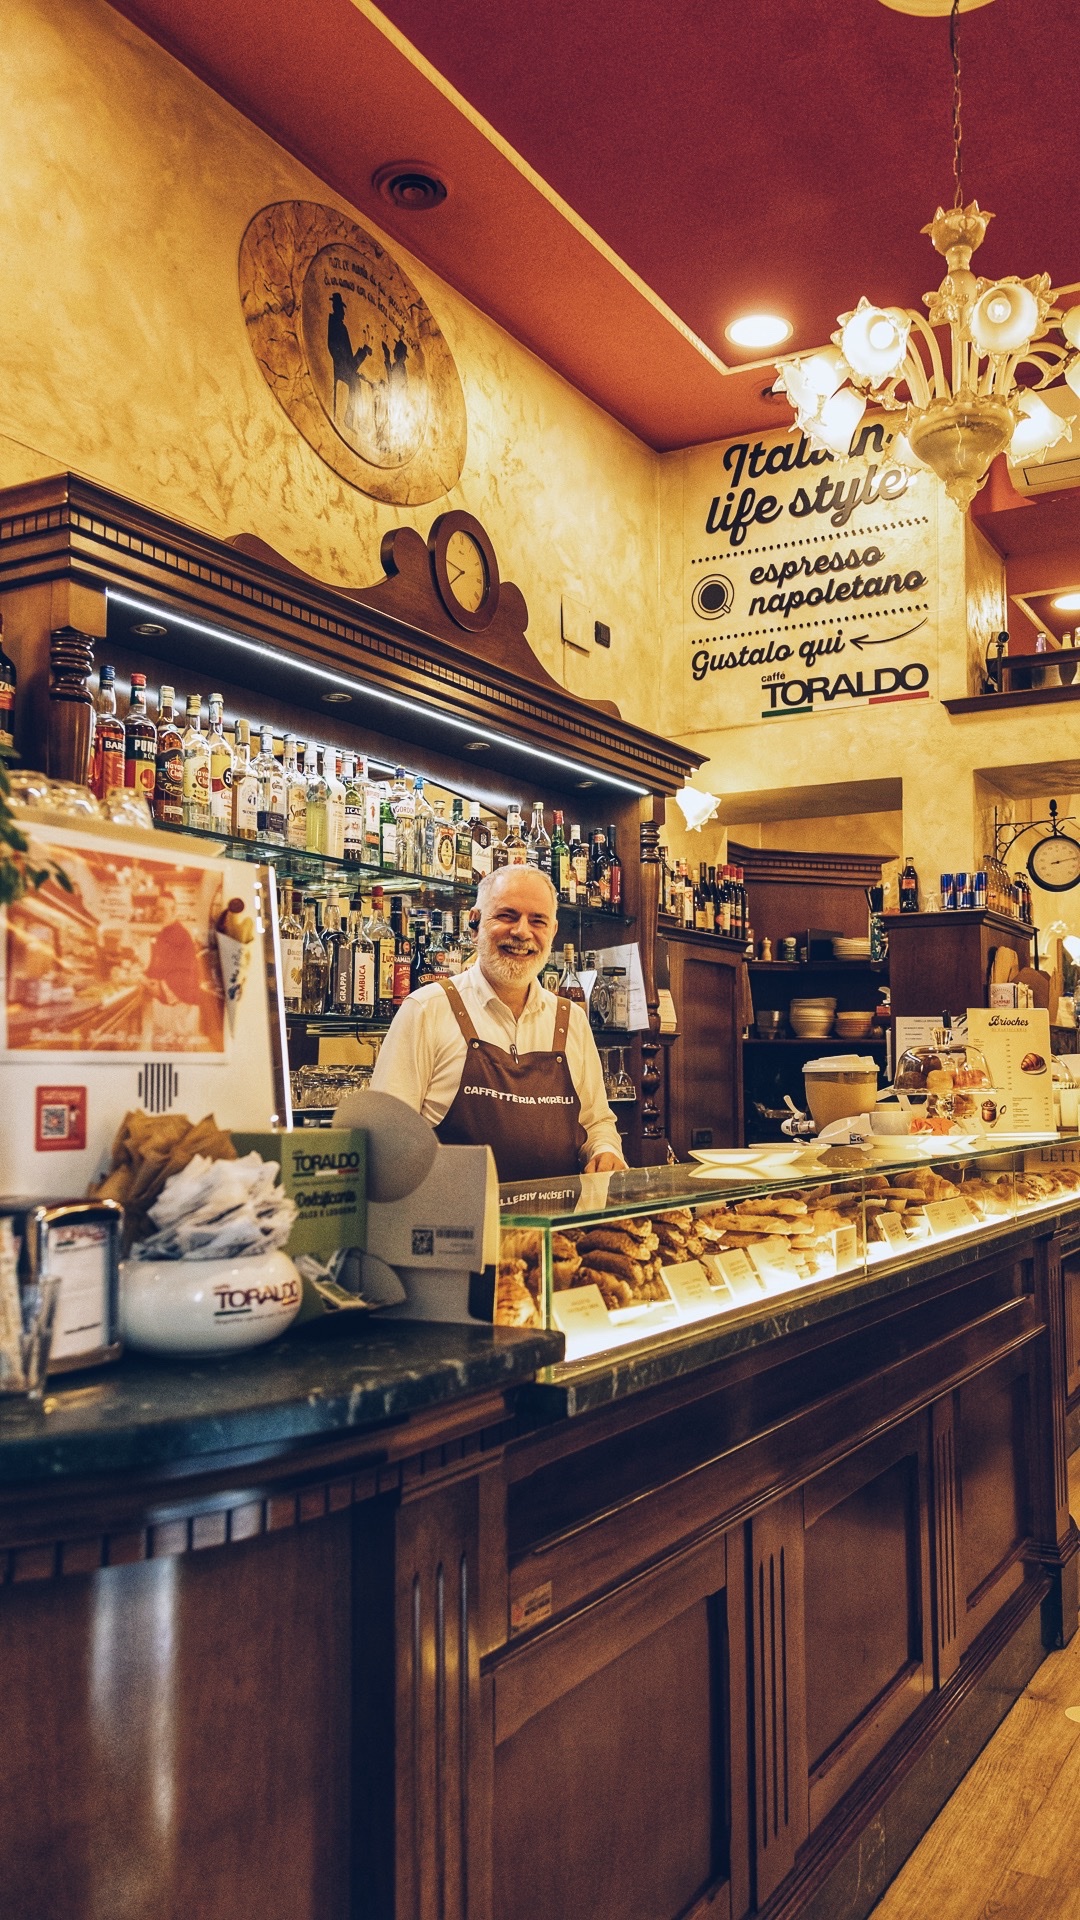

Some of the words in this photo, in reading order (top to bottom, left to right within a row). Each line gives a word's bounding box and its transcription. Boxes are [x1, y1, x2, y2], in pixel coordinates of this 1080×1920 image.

[723, 423, 891, 488] Italn
[705, 488, 784, 546] life
[789, 464, 909, 527] style
[750, 546, 885, 588] espresso
[749, 570, 928, 617] napoletano
[692, 641, 794, 681] Gustalo
[798, 630, 845, 668] qui
[762, 663, 929, 708] TORALDO
[345, 807, 361, 816] ICA
[358, 964, 366, 1002] SAMBUCA
[988, 1014, 1029, 1027] Brioches
[464, 1086, 536, 1105] CAFFETTERIA
[292, 1152, 360, 1172] TORALDO
